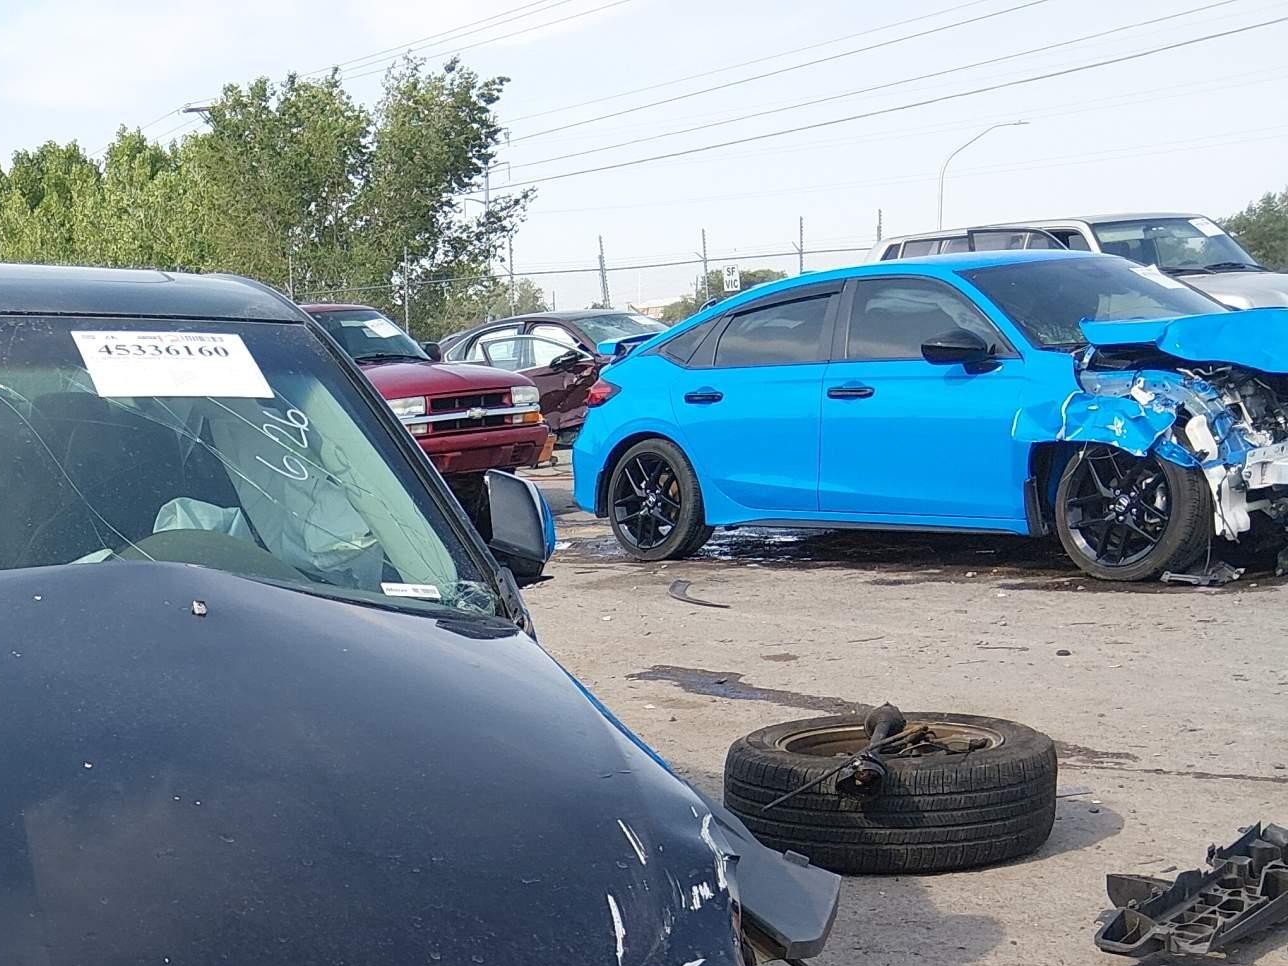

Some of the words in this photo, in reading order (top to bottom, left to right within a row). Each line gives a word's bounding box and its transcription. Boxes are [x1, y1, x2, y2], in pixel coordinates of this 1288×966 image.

[726, 266, 736, 277] SF
[725, 279, 739, 289] VIC
[98, 344, 230, 358] 45336160
